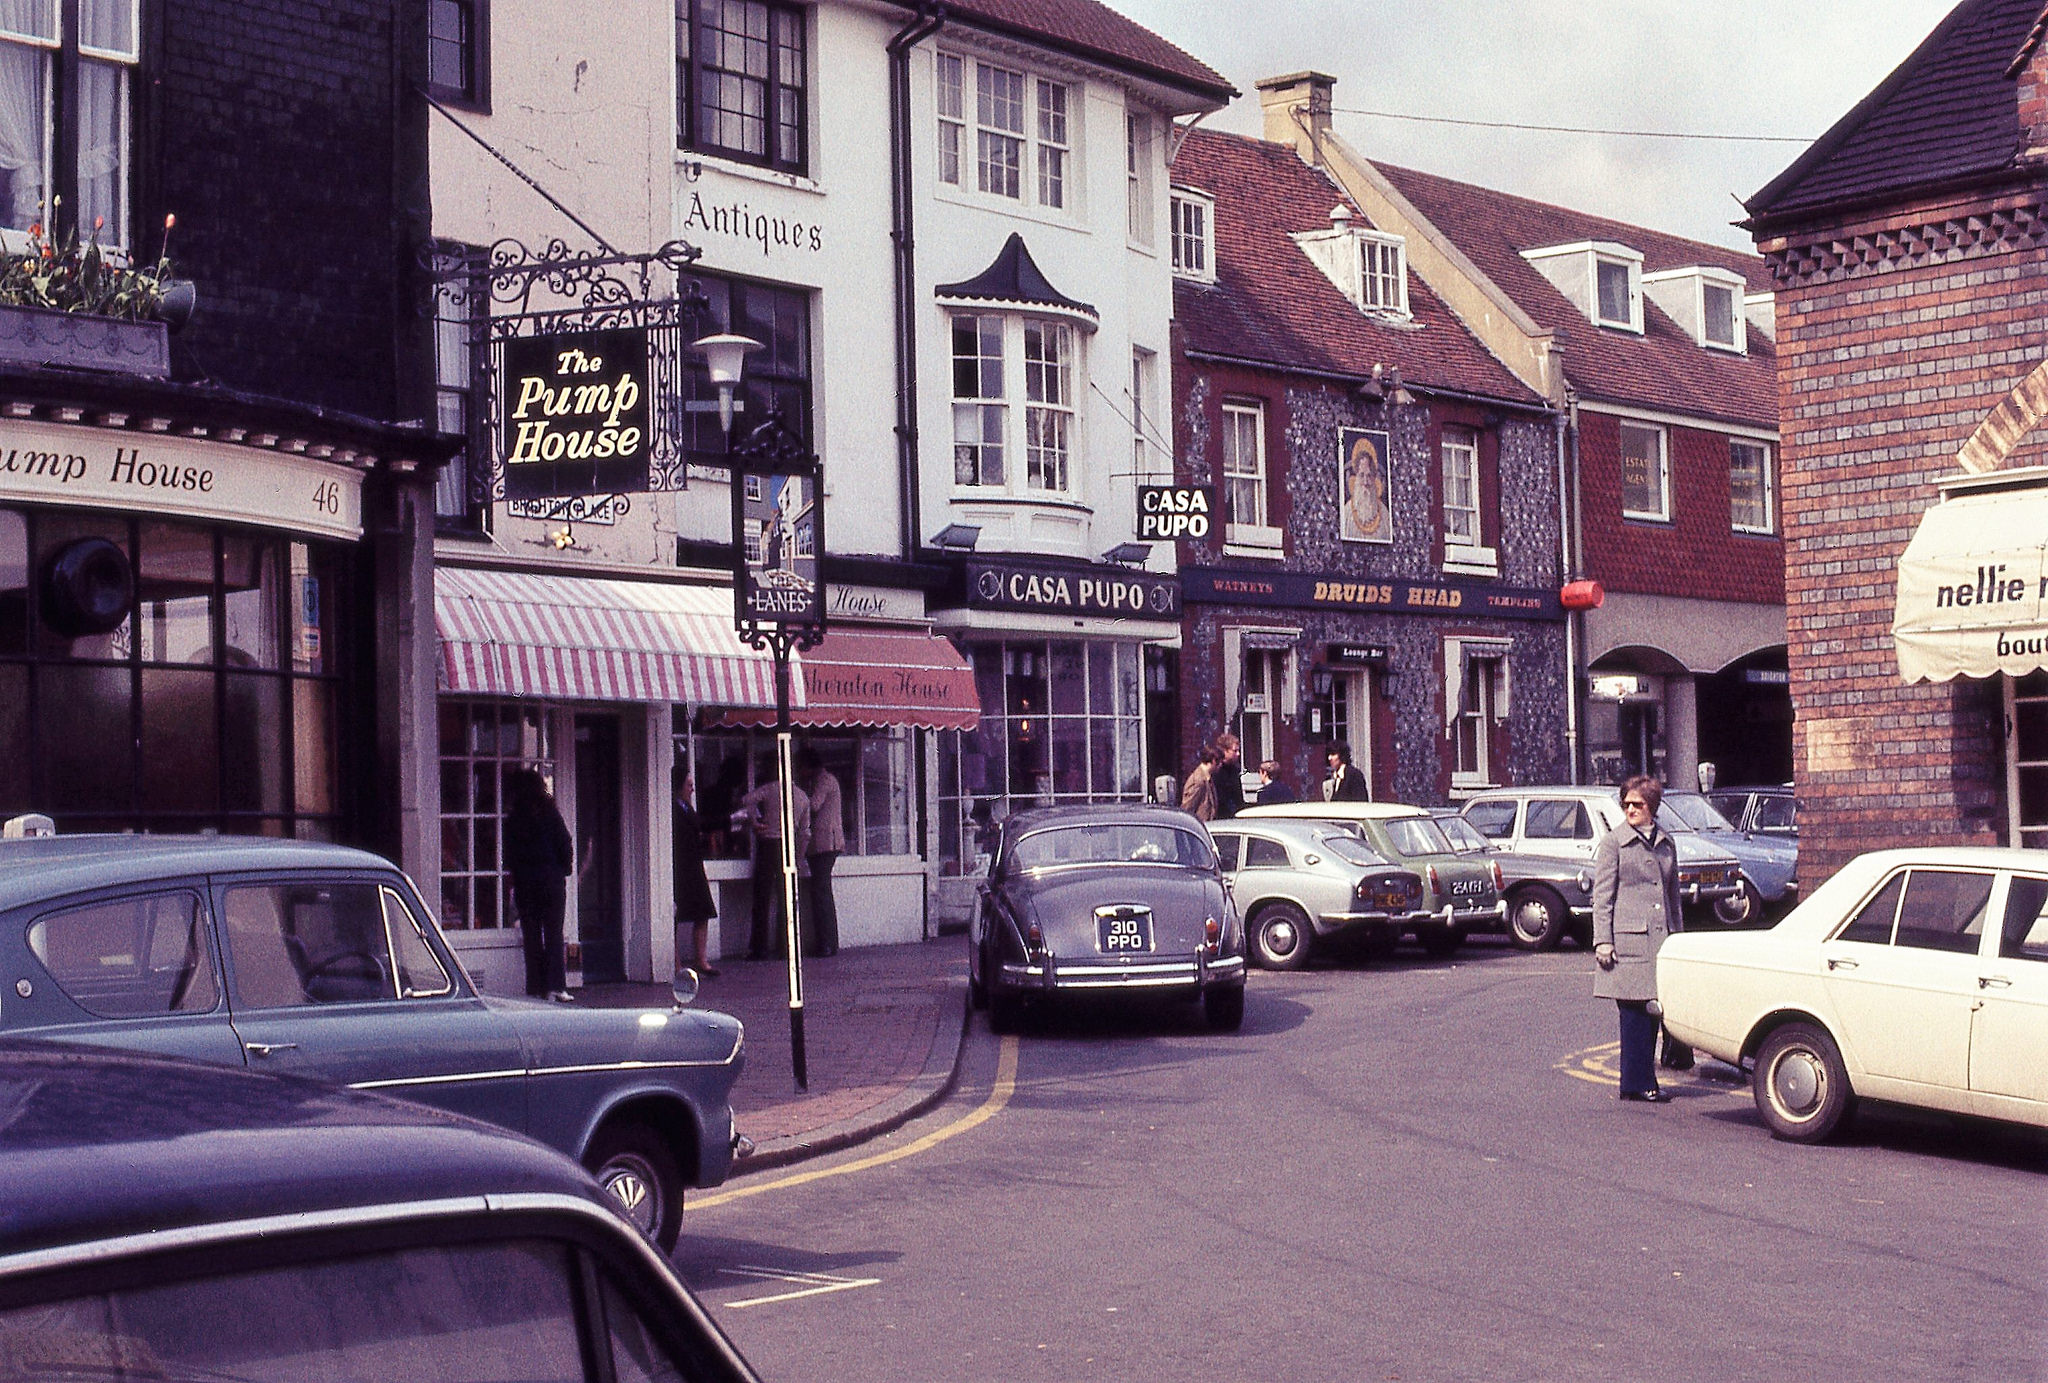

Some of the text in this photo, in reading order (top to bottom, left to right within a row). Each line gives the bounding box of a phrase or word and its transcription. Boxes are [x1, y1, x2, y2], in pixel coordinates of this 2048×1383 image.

[685, 192, 822, 255] Antiques
[558, 349, 602, 375] The
[512, 373, 639, 426] Pump
[508, 421, 640, 464] House
[111, 448, 214, 492] House
[313, 481, 339, 514] 46
[1143, 490, 1208, 512] CASA
[1142, 515, 1209, 537] PUPO
[829, 586, 888, 613] House
[1010, 574, 1144, 611] CASA PUPO
[1214, 580, 1273, 593] WATNEYS
[1314, 582, 1393, 604] DRUIDS
[1407, 587, 1462, 608] HEAD
[1937, 564, 2025, 608] nellie
[756, 591, 807, 613] LANES
[892, 671, 950, 699] House
[1107, 934, 1142, 949] PPO
[1110, 921, 1138, 934] 310
